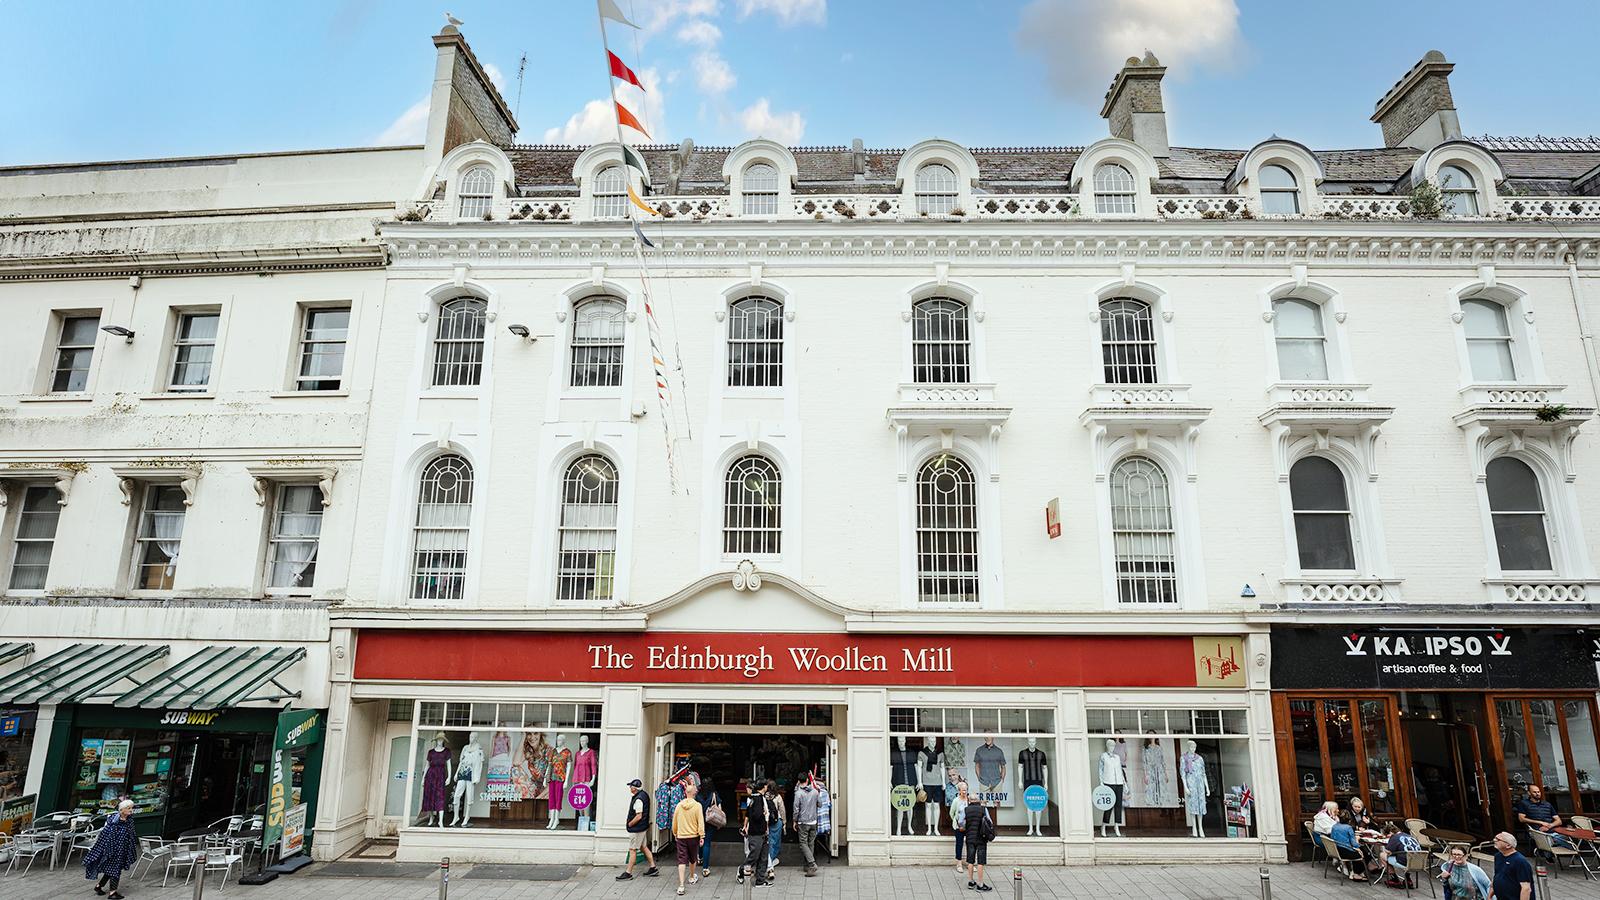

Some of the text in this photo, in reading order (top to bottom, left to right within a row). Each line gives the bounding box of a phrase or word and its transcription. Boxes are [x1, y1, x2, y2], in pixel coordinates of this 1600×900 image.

[1373, 636, 1483, 656] KAIPSO
[588, 645, 953, 677] The Edinburgh Woollen Mill
[1382, 663, 1483, 673] artisan coffee & food
[160, 711, 219, 725] SUBWAY
[285, 713, 319, 744] SUBWAY
[268, 749, 285, 827] SUBWA
[488, 783, 514, 792] SUMMER
[504, 792, 522, 801] HERE
[573, 795, 586, 804] £14
[985, 792, 1008, 800] READY
[1096, 796, 1112, 804] £18
[897, 798, 910, 806] £40
